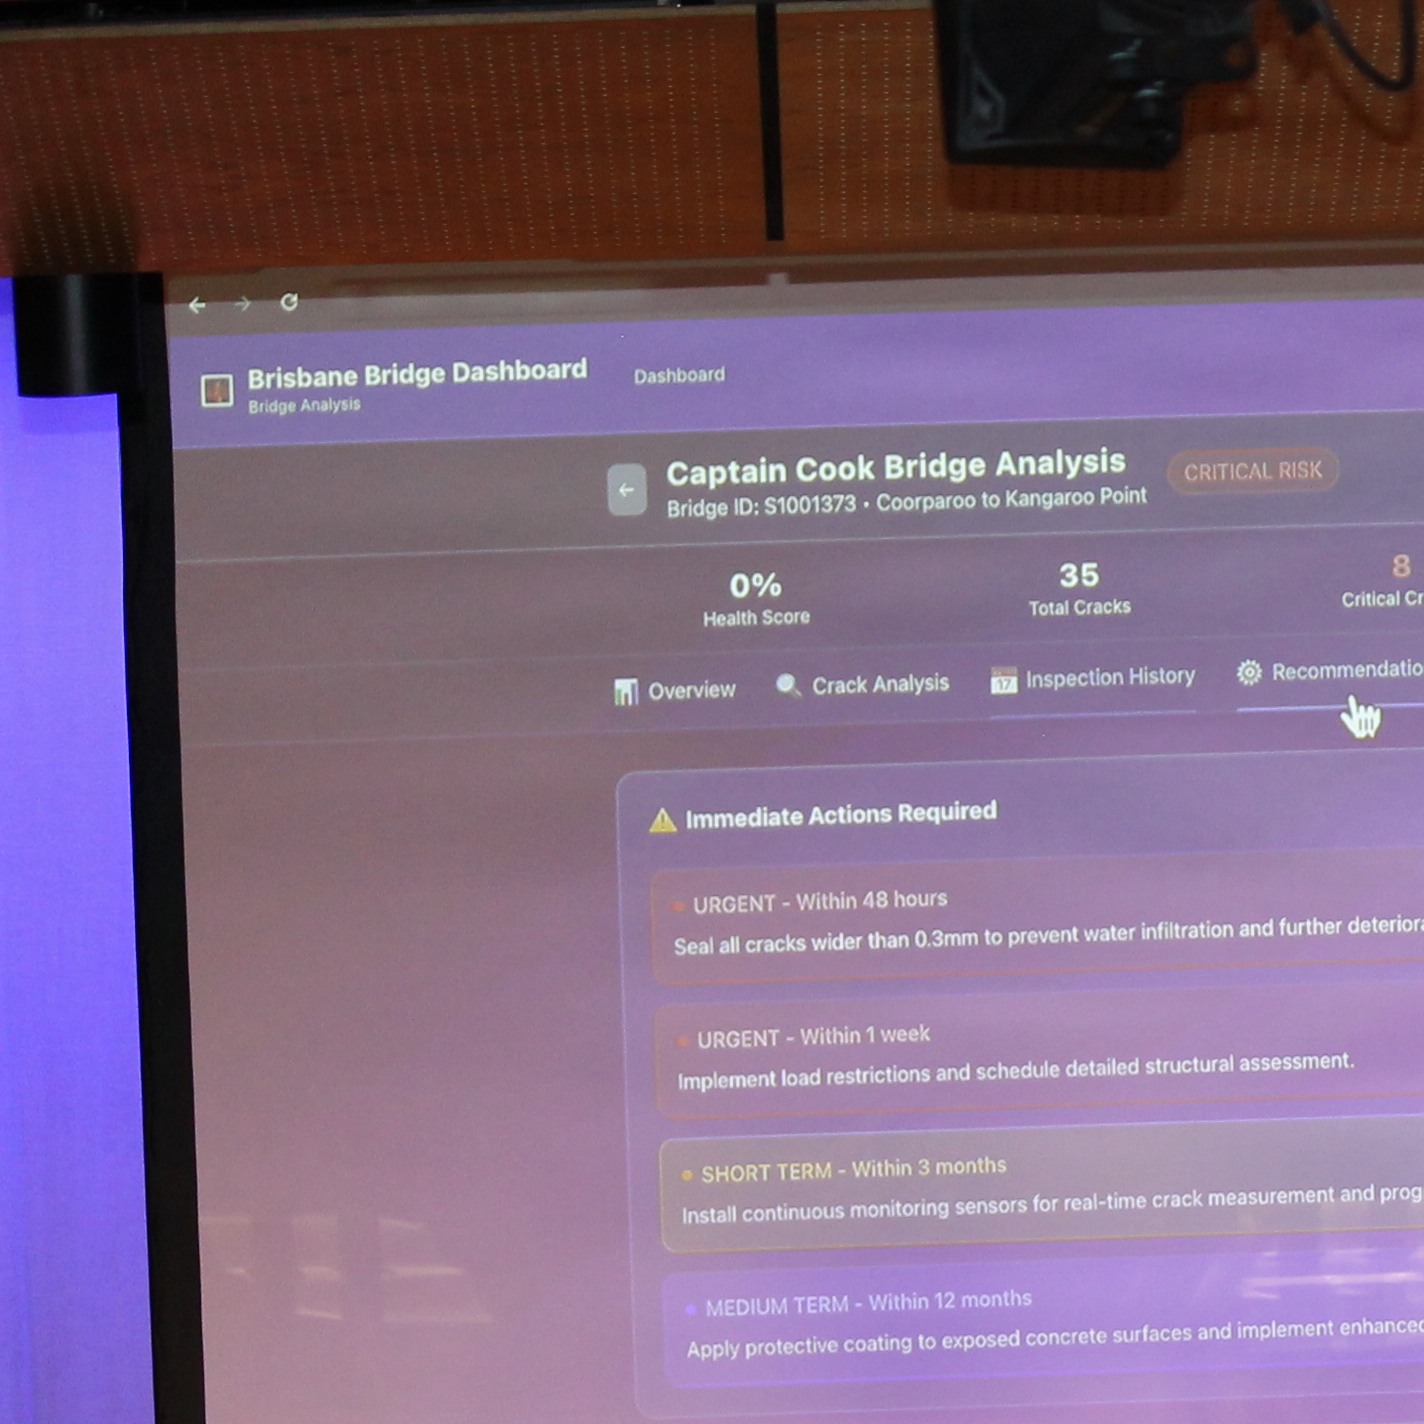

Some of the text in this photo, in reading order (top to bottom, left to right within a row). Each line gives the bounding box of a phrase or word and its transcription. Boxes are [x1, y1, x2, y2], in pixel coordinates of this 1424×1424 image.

[248, 356, 588, 390] Brisbane Bridge Dashboard
[634, 365, 726, 386] Dashboard
[248, 396, 362, 417] Bridge Analysis
[666, 446, 1126, 490] Captain Cook Bridge Analysis
[1184, 460, 1323, 482] CRITICAL RISK
[667, 498, 729, 521] Bridge
[734, 497, 760, 516] ID:
[764, 494, 857, 516] S1001373
[876, 492, 977, 514] Coorparoo
[981, 491, 1001, 509] to
[1005, 489, 1095, 511] Kangaroo
[1100, 485, 1148, 505] Point
[1059, 562, 1100, 588] 35
[1392, 553, 1411, 579] 8
[730, 572, 782, 599] 0%
[1028, 598, 1132, 617] Total Cracks
[1341, 590, 1401, 608] Critical
[703, 608, 811, 628] Health Score
[648, 679, 737, 701] Overview
[812, 672, 950, 696] Crack Analysis
[1026, 665, 1196, 691] Inspection History
[686, 799, 997, 830] Immediate Actions Required
[693, 893, 776, 915] URGENT
[795, 890, 858, 911] Within
[862, 890, 889, 909] 48
[893, 889, 948, 908] hours
[674, 936, 714, 956] Seal
[718, 935, 740, 955] all
[745, 933, 807, 954] cracks
[810, 932, 863, 952] wider
[867, 930, 910, 950] than
[914, 929, 979, 949] 0.3mm
[984, 929, 1003, 946] to
[1008, 925, 1079, 949] prevent
[1083, 924, 1136, 942] water
[1141, 919, 1234, 940] infiltration
[1239, 918, 1274, 938] and
[1278, 916, 1343, 936] further
[697, 1028, 781, 1050] URGENT
[800, 1025, 861, 1046] Within
[865, 1025, 875, 1043] 1
[880, 1023, 931, 1043] week
[678, 1051, 1355, 1094] Implement load restrictions and schedule detailed structural assessment.
[701, 1163, 772, 1184] SHORT
[776, 1161, 832, 1181] TERM
[851, 1158, 913, 1178] Within
[918, 1158, 931, 1176] 3
[935, 1155, 1007, 1176] months
[682, 1204, 737, 1225] Install
[742, 1202, 846, 1223] continuous
[850, 1198, 950, 1220] monitoring
[954, 1199, 1028, 1216] sensors
[1032, 1193, 1059, 1213] for
[1064, 1191, 1147, 1211] real-time
[1152, 1189, 1204, 1209] crack
[1208, 1186, 1335, 1207] measurement
[1340, 1183, 1375, 1203] and
[706, 1297, 788, 1317] MEDIUM
[793, 1294, 849, 1314] TERM
[868, 1292, 930, 1312] Within
[934, 1291, 956, 1310] 12
[961, 1288, 1033, 1308] months
[687, 1339, 741, 1361] Apply
[745, 1335, 839, 1360] protective
[843, 1333, 913, 1355] coating
[917, 1334, 937, 1350] to
[941, 1329, 1021, 1352] exposed
[1025, 1328, 1108, 1347] concrete
[1112, 1324, 1193, 1344] surfaces
[1197, 1321, 1232, 1341] and
[1237, 1319, 1335, 1342] implement
